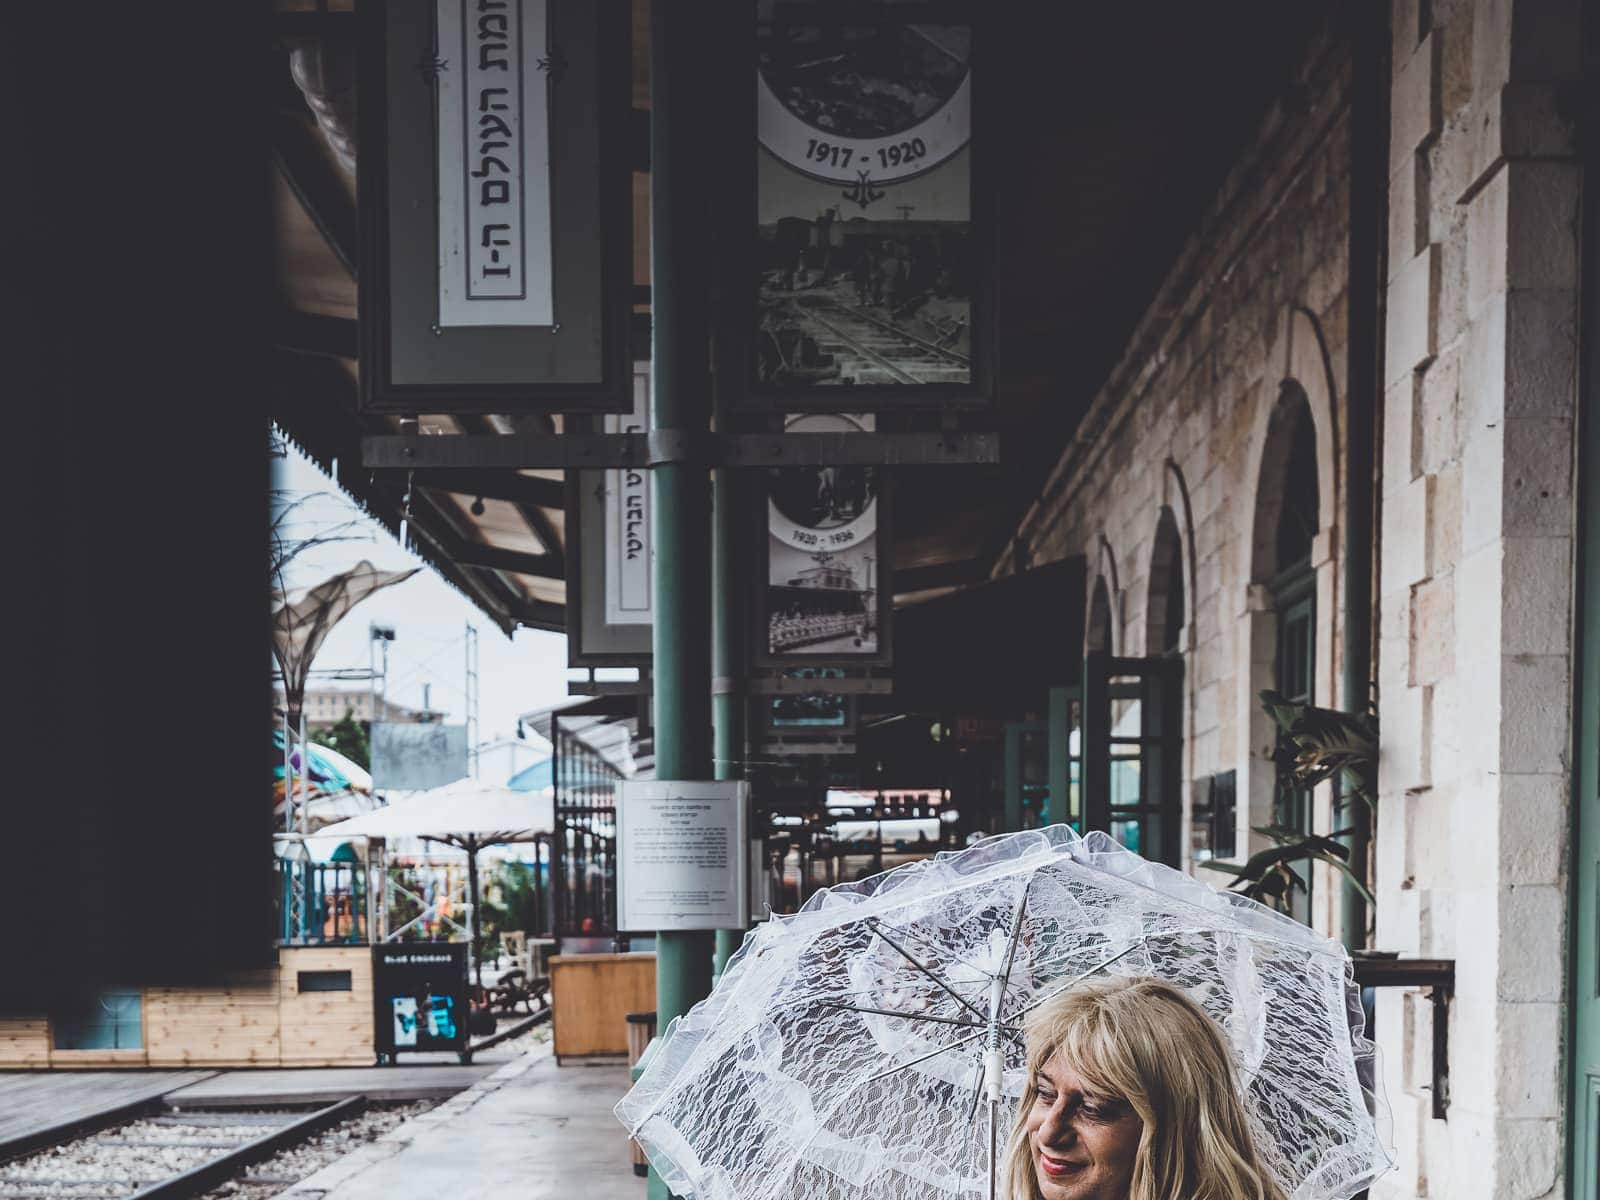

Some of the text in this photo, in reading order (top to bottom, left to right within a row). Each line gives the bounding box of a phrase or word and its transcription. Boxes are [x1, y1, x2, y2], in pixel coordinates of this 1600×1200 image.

[473, 87, 511, 206] העולם
[805, 138, 854, 168] 1917
[877, 137, 927, 168] 1920
[626, 494, 643, 560] הבריטי
